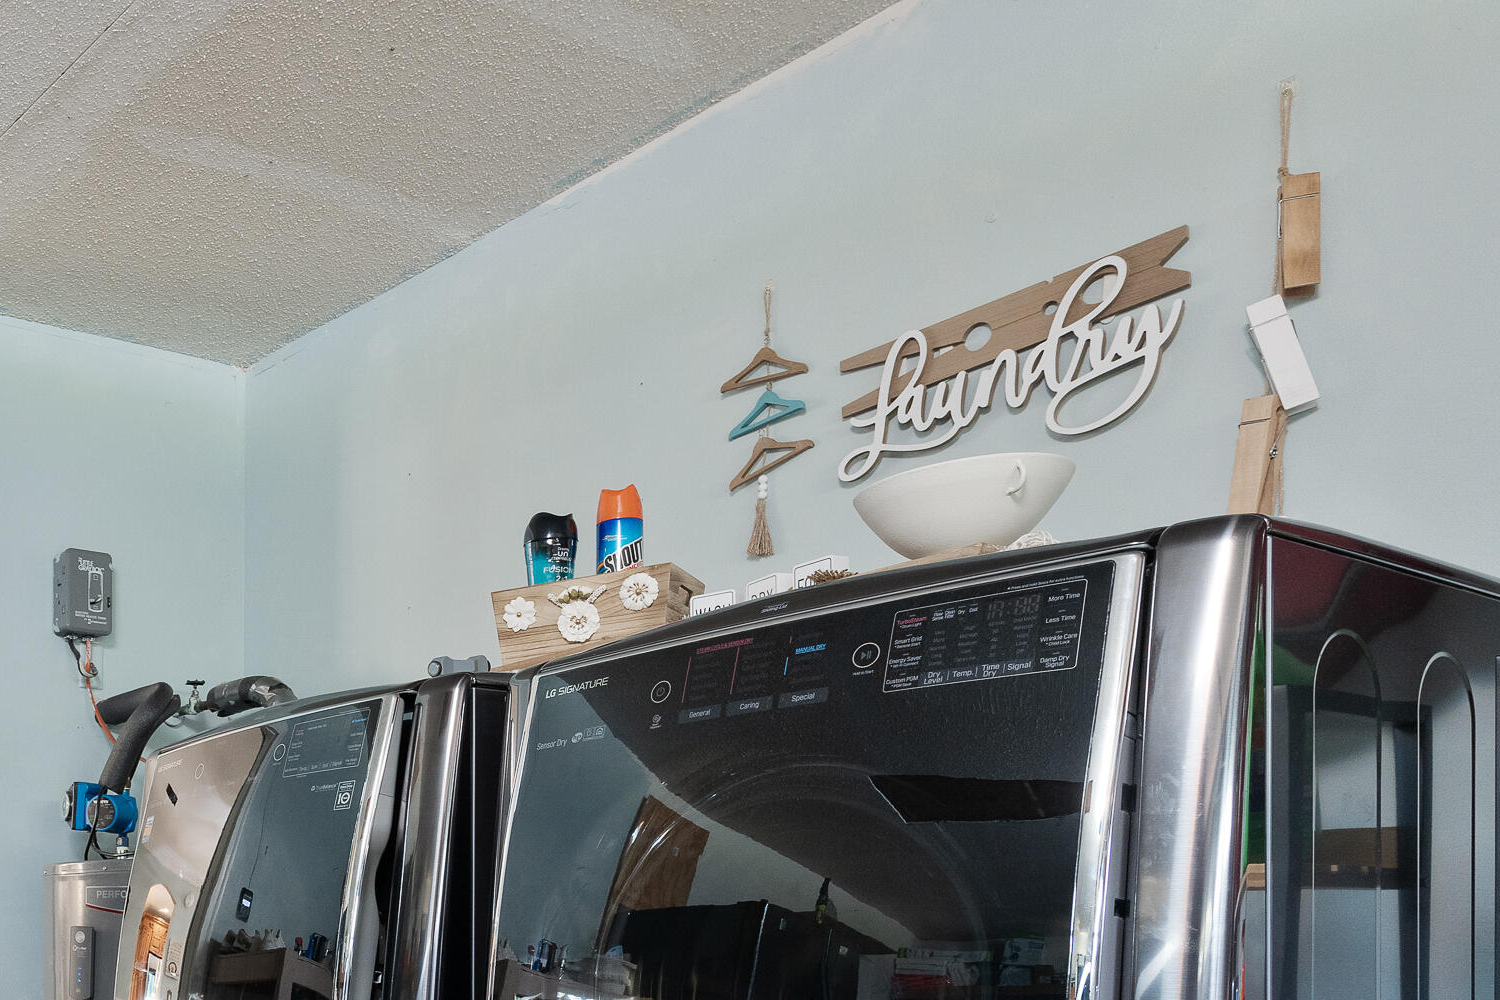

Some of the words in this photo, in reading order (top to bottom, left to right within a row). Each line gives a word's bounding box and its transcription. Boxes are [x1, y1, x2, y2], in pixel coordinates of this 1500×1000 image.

[1065, 592, 1081, 600] Time
[1063, 632, 1078, 640] Care
[894, 638, 911, 646] Smart
[1040, 656, 1058, 664] Damp
[1058, 654, 1070, 662] Dry
[982, 663, 1000, 671] Time
[1007, 661, 1032, 671] Signal
[927, 671, 941, 679] Dry
[982, 669, 997, 678] Dry
[924, 676, 943, 685] Level
[545, 689, 556, 699] LG
[557, 676, 610, 696] SIGNATURE
[791, 692, 816, 702] Special
[739, 701, 760, 710] Caring
[688, 709, 712, 719] General
[536, 741, 557, 751] Sensor
[556, 738, 568, 748] Dry
